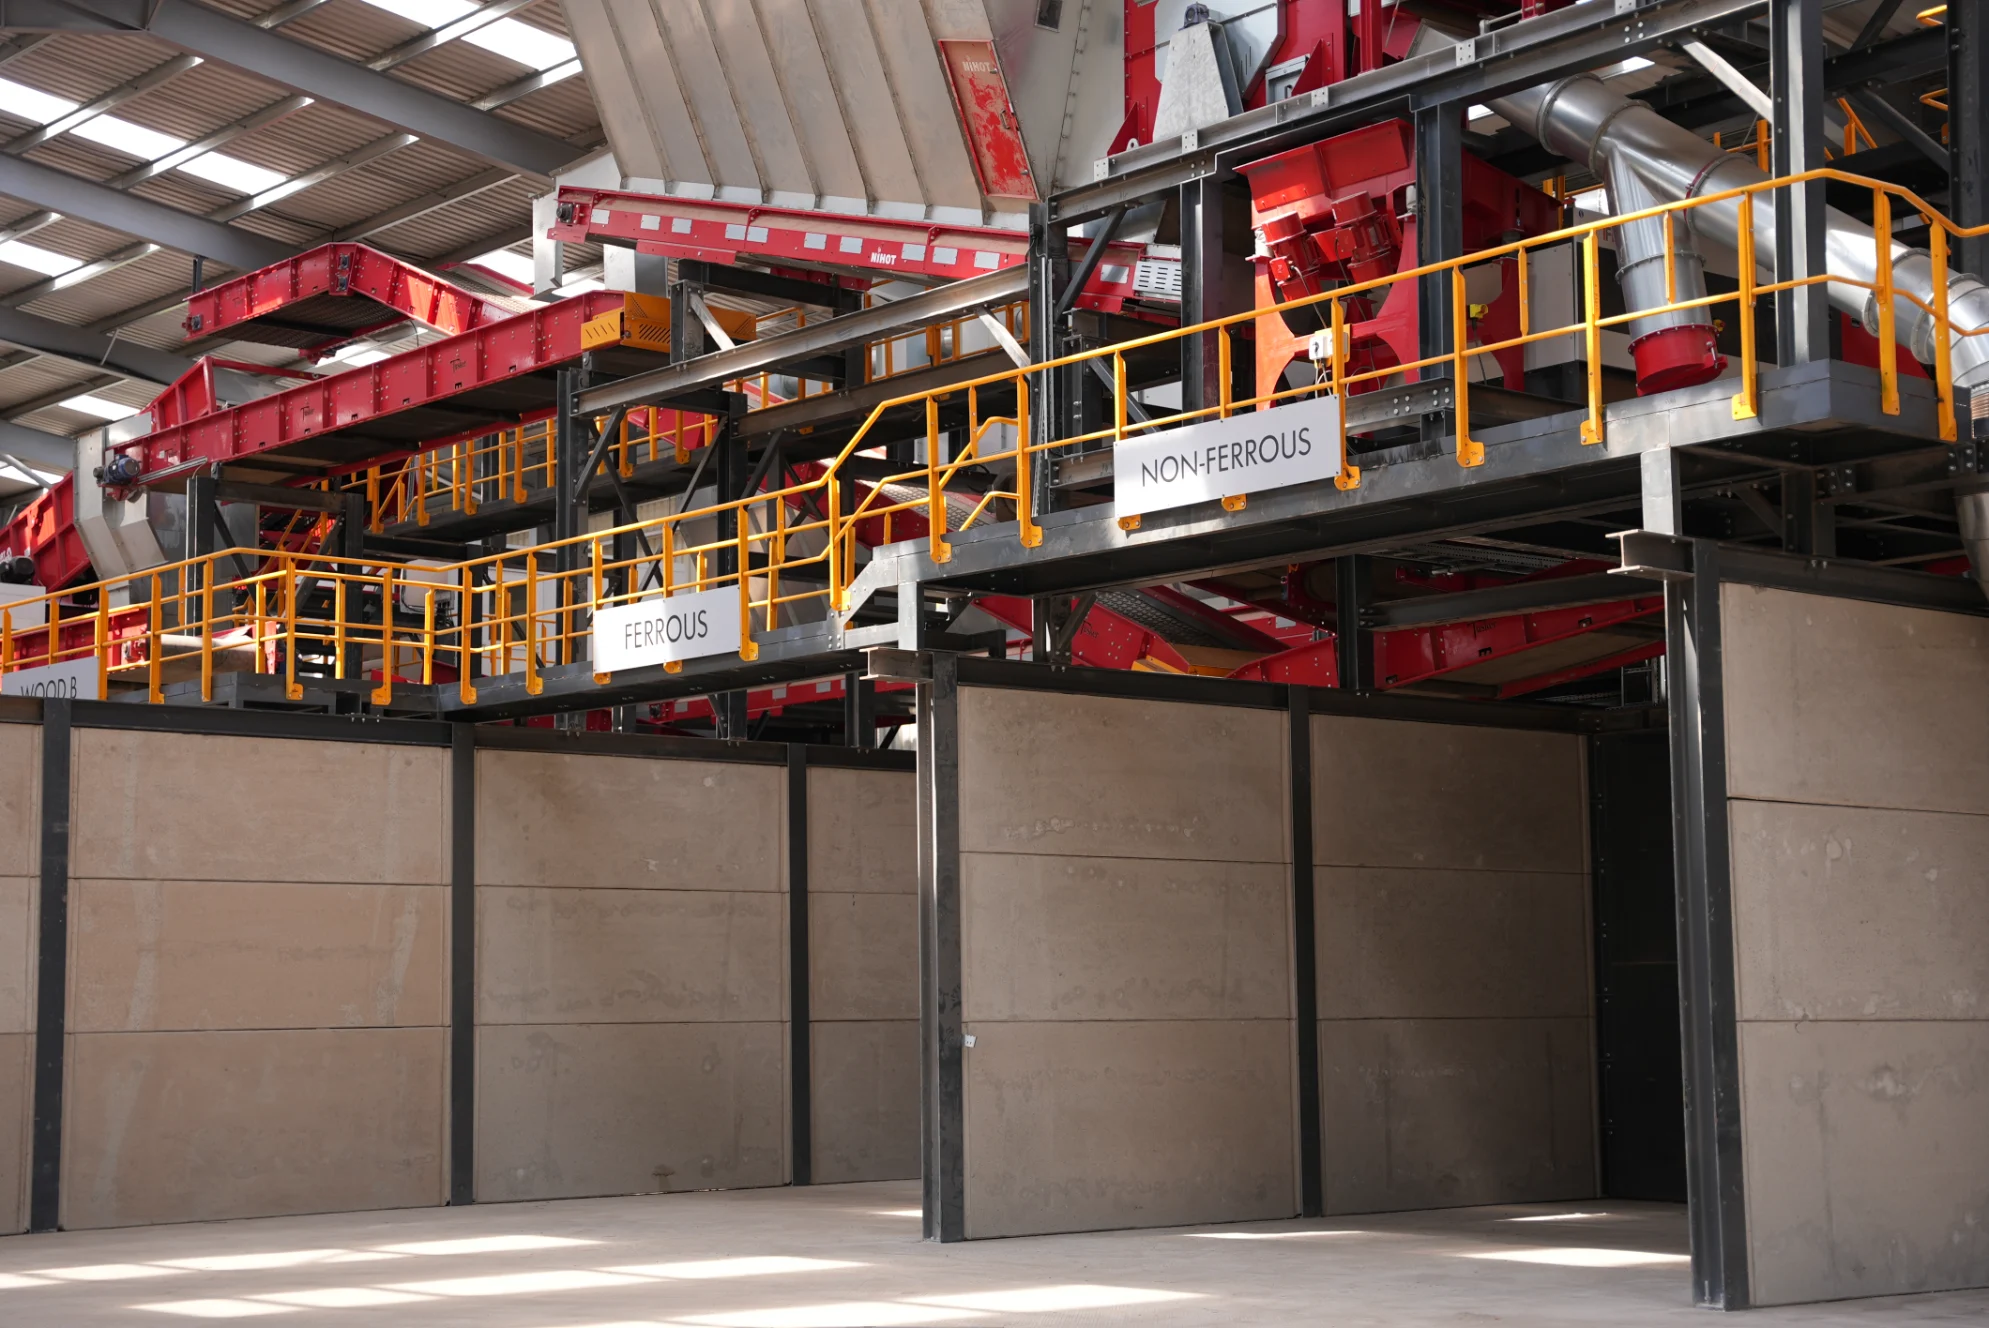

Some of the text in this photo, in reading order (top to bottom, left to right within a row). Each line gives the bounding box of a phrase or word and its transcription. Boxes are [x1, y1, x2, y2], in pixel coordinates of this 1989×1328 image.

[1142, 427, 1311, 487] NON-FERROUS
[625, 610, 708, 650] FERROUS
[70, 676, 77, 699] B
